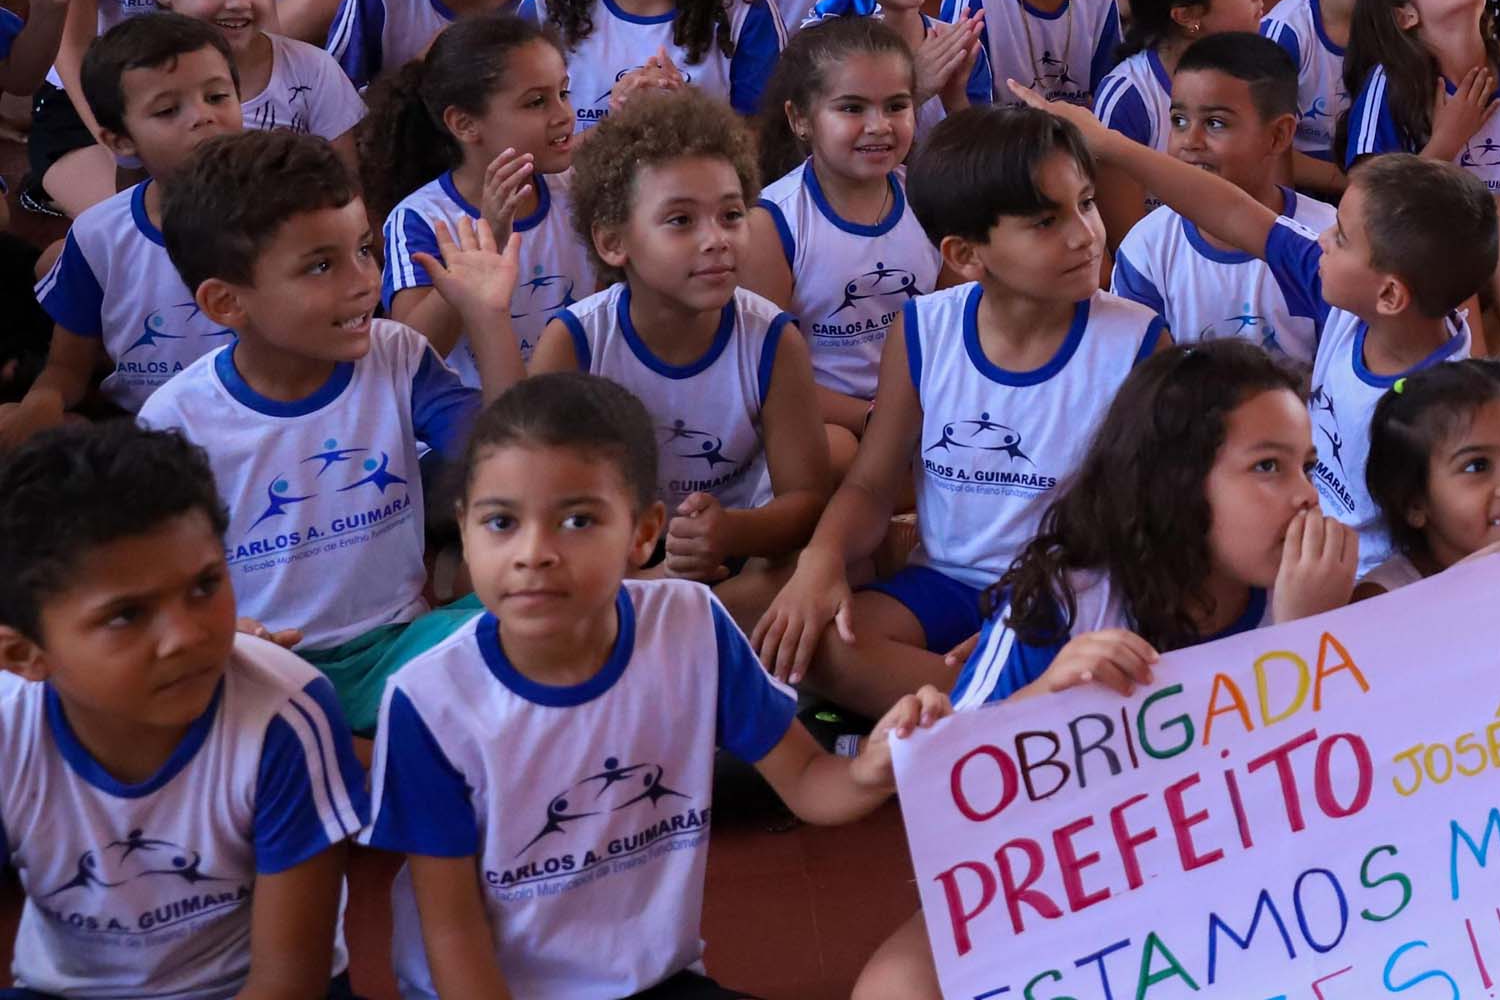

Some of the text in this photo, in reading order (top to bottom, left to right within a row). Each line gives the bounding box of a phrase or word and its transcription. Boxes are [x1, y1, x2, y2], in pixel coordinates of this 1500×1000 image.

[812, 319, 878, 335] CARLOS A.
[117, 361, 168, 373] ARLOS
[922, 459, 954, 477] RLOS
[957, 469, 970, 480] A.
[975, 470, 1057, 488] GUIMARÃES
[1315, 458, 1356, 512] MARÃES
[307, 526, 325, 541] A.
[950, 631, 1370, 822] OBRIGADA
[486, 853, 576, 885] CARLOS
[583, 851, 603, 867] A.
[607, 808, 713, 855] GUIMARÃE
[973, 845, 1414, 1000] TAMOS
